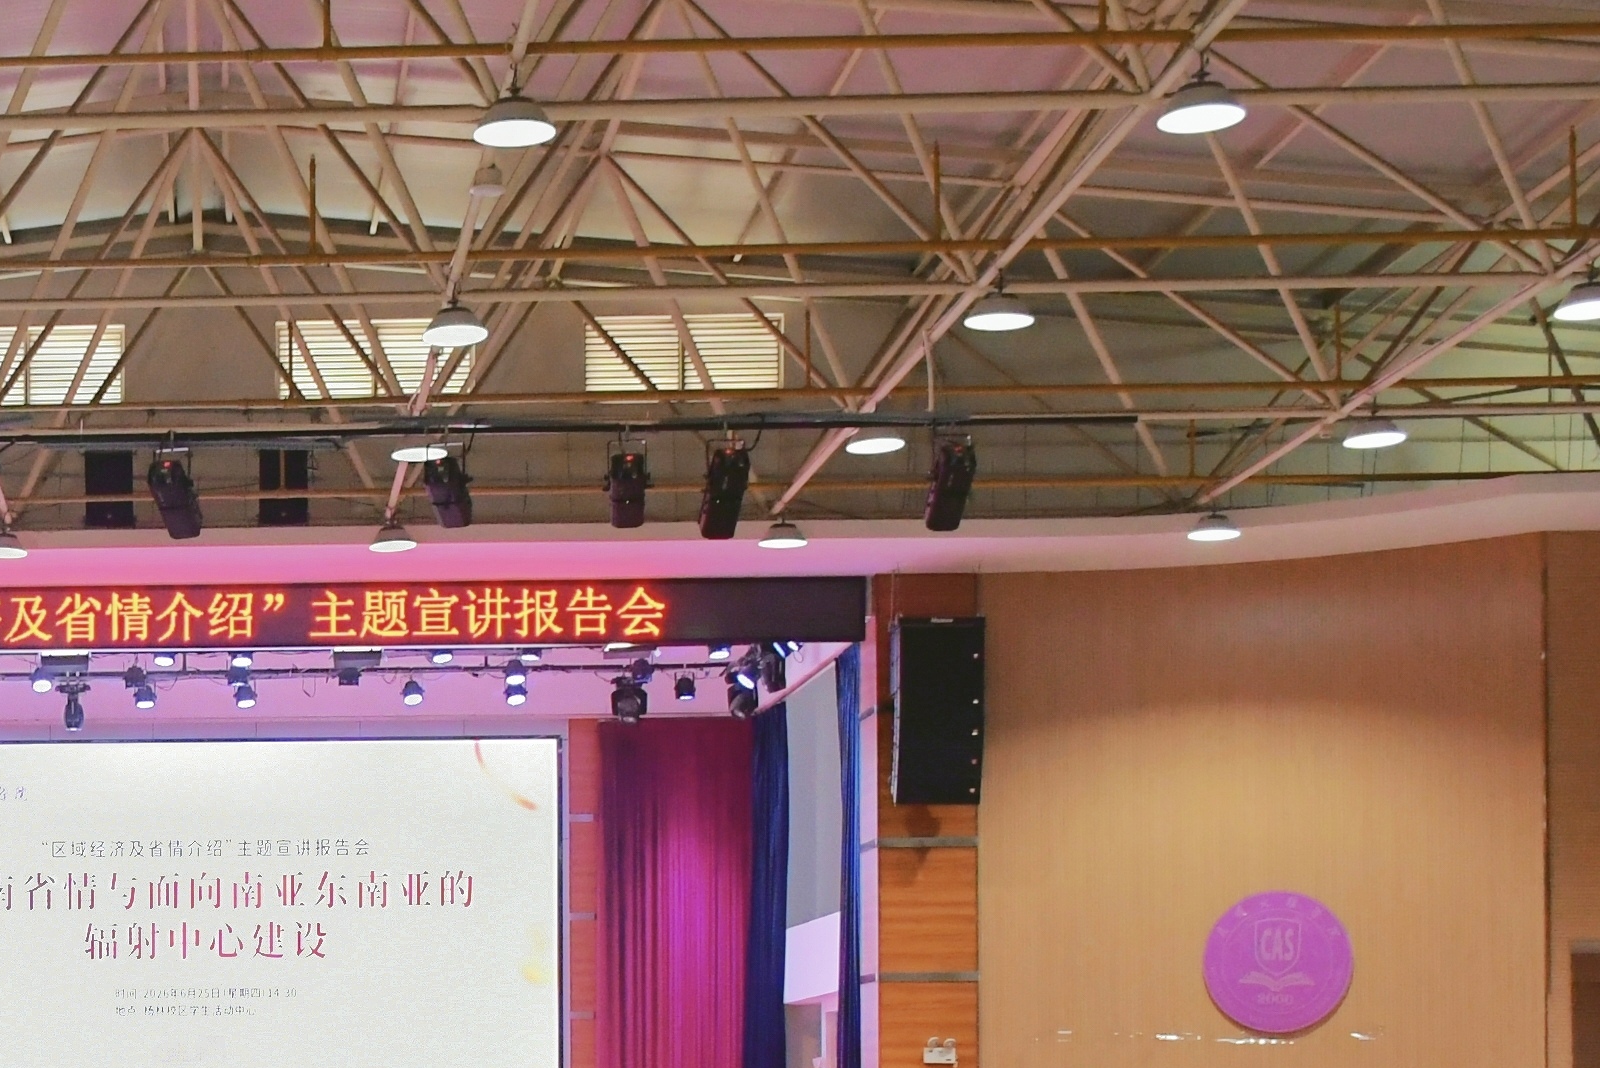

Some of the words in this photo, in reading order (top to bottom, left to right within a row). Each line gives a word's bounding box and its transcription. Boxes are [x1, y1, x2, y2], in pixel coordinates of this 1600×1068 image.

[84, 921, 328, 960] 辐射中心建设
